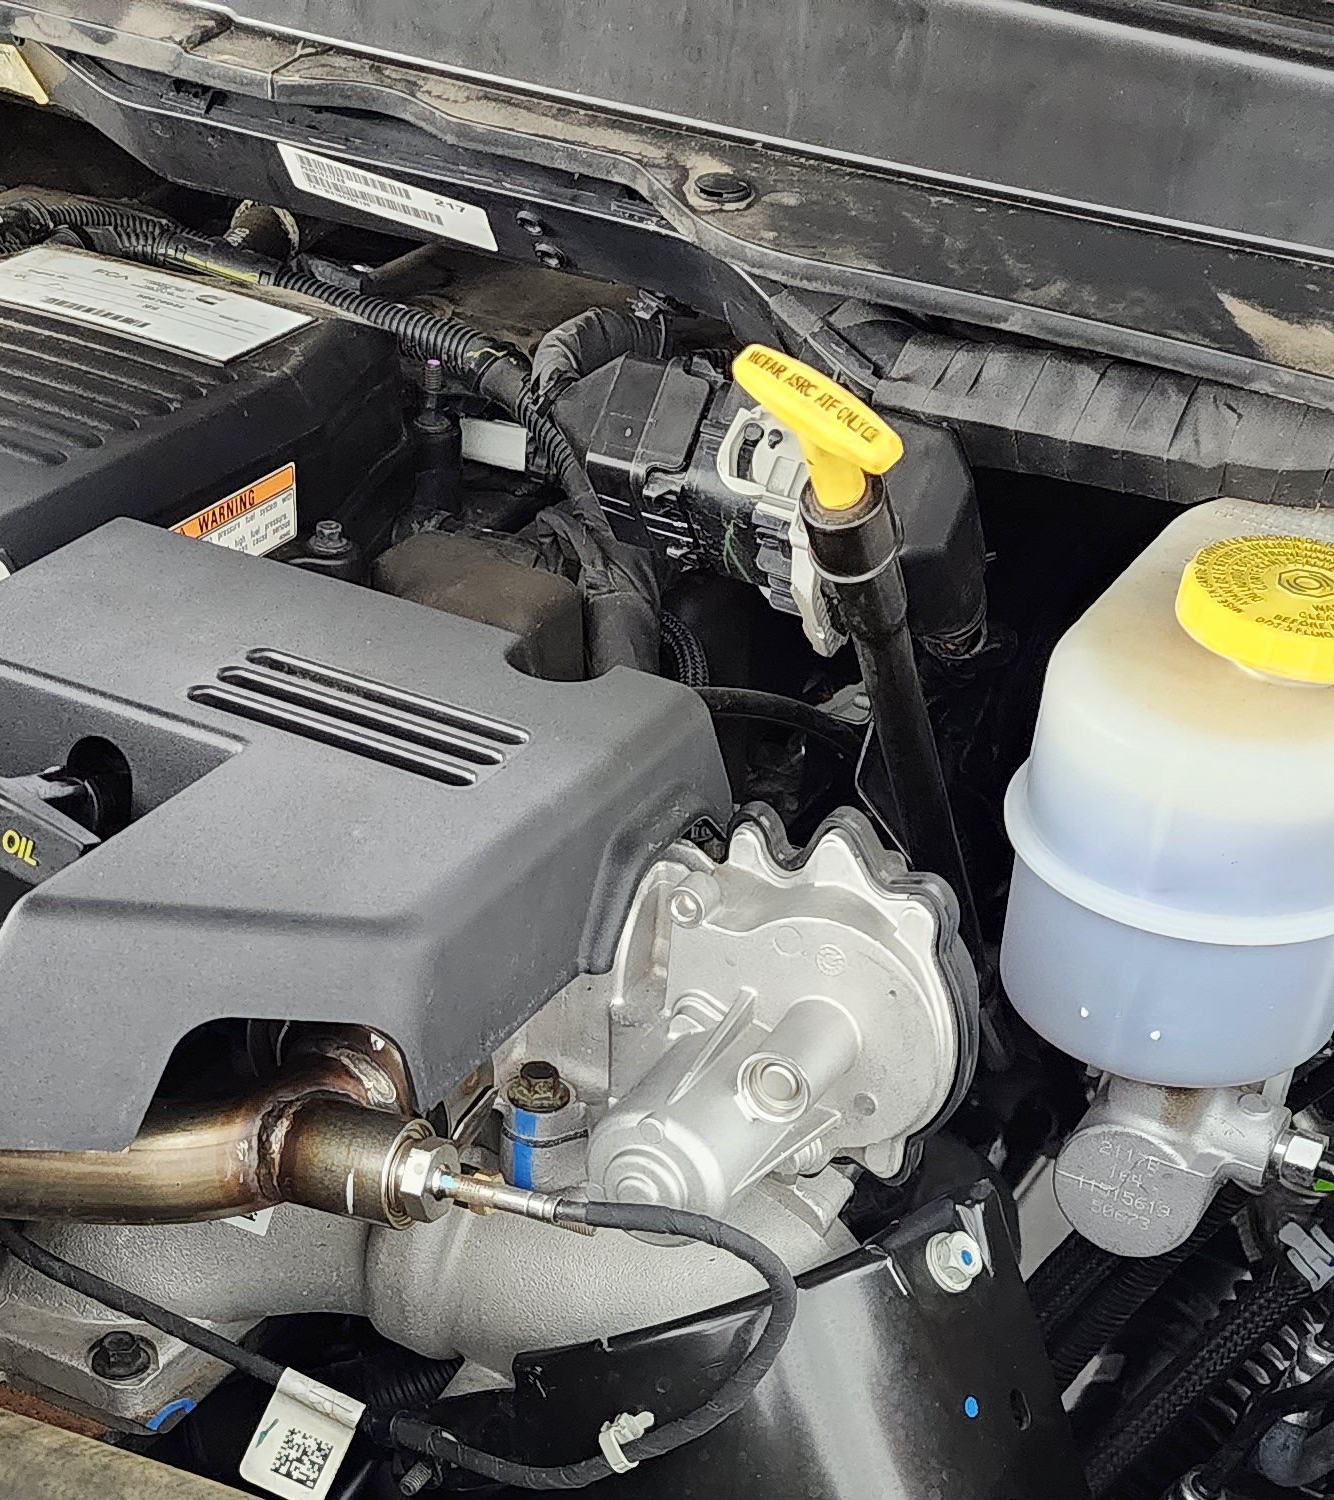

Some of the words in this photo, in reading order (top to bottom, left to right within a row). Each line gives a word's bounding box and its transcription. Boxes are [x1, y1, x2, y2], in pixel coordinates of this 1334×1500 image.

[433, 198, 466, 213] 217
[198, 489, 255, 534] WARNING
[2, 829, 38, 867] OIL
